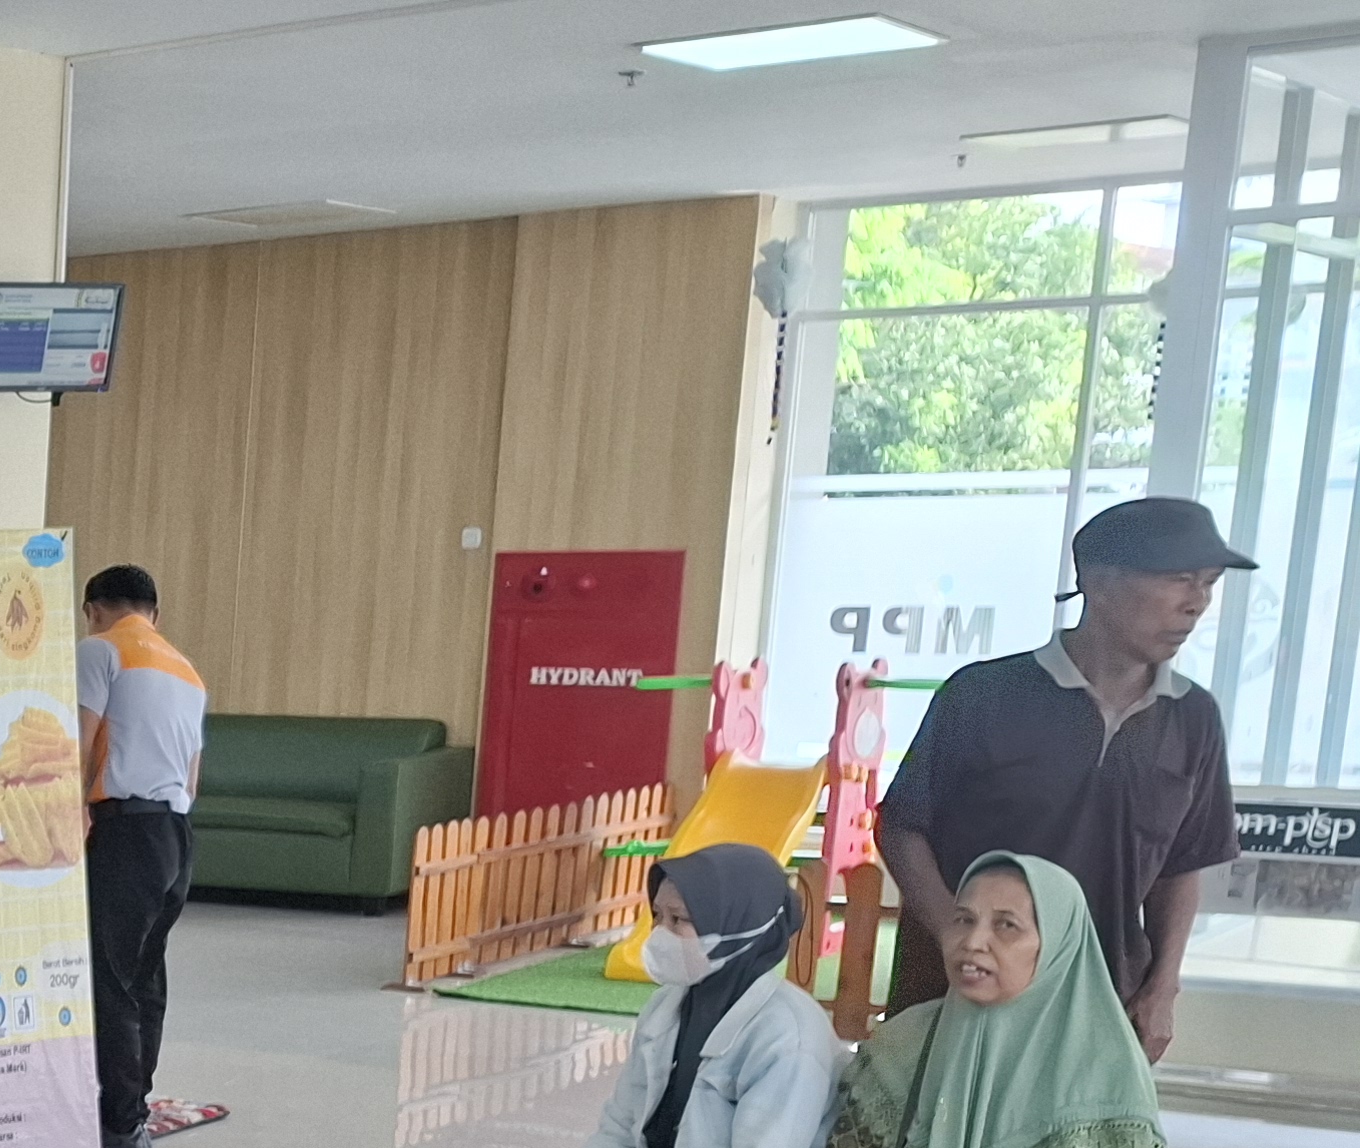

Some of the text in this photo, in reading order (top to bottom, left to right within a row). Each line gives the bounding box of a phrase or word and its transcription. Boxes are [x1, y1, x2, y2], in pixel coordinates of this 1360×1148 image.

[26, 548, 59, 559] CONTOH
[530, 666, 644, 687] HYDRANT
[49, 973, 79, 989] 200gr
